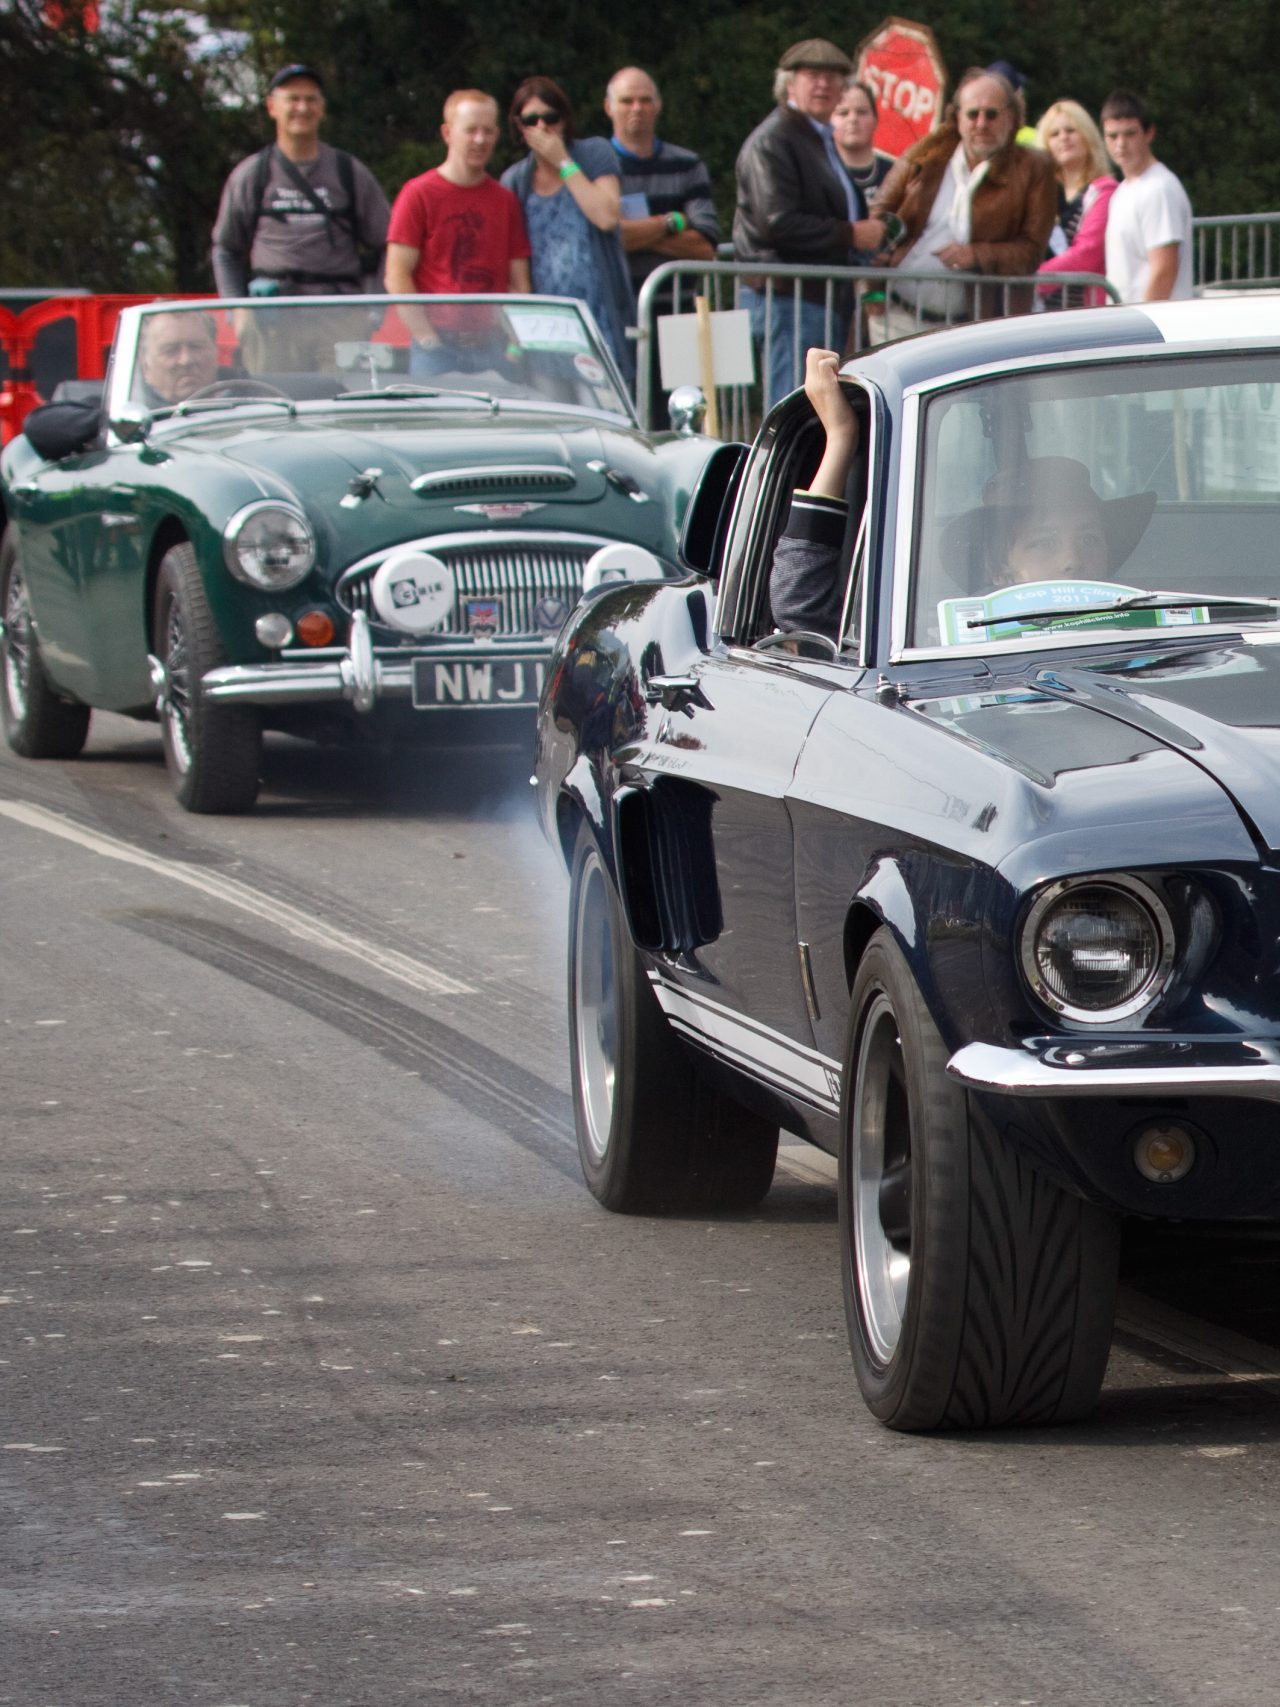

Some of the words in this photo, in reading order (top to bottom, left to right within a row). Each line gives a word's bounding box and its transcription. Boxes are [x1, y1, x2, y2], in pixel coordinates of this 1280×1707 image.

[864, 65, 934, 122] STOP
[1014, 589, 1047, 600] Kop
[1051, 586, 1074, 595] Hill
[1052, 594, 1089, 602] 2011
